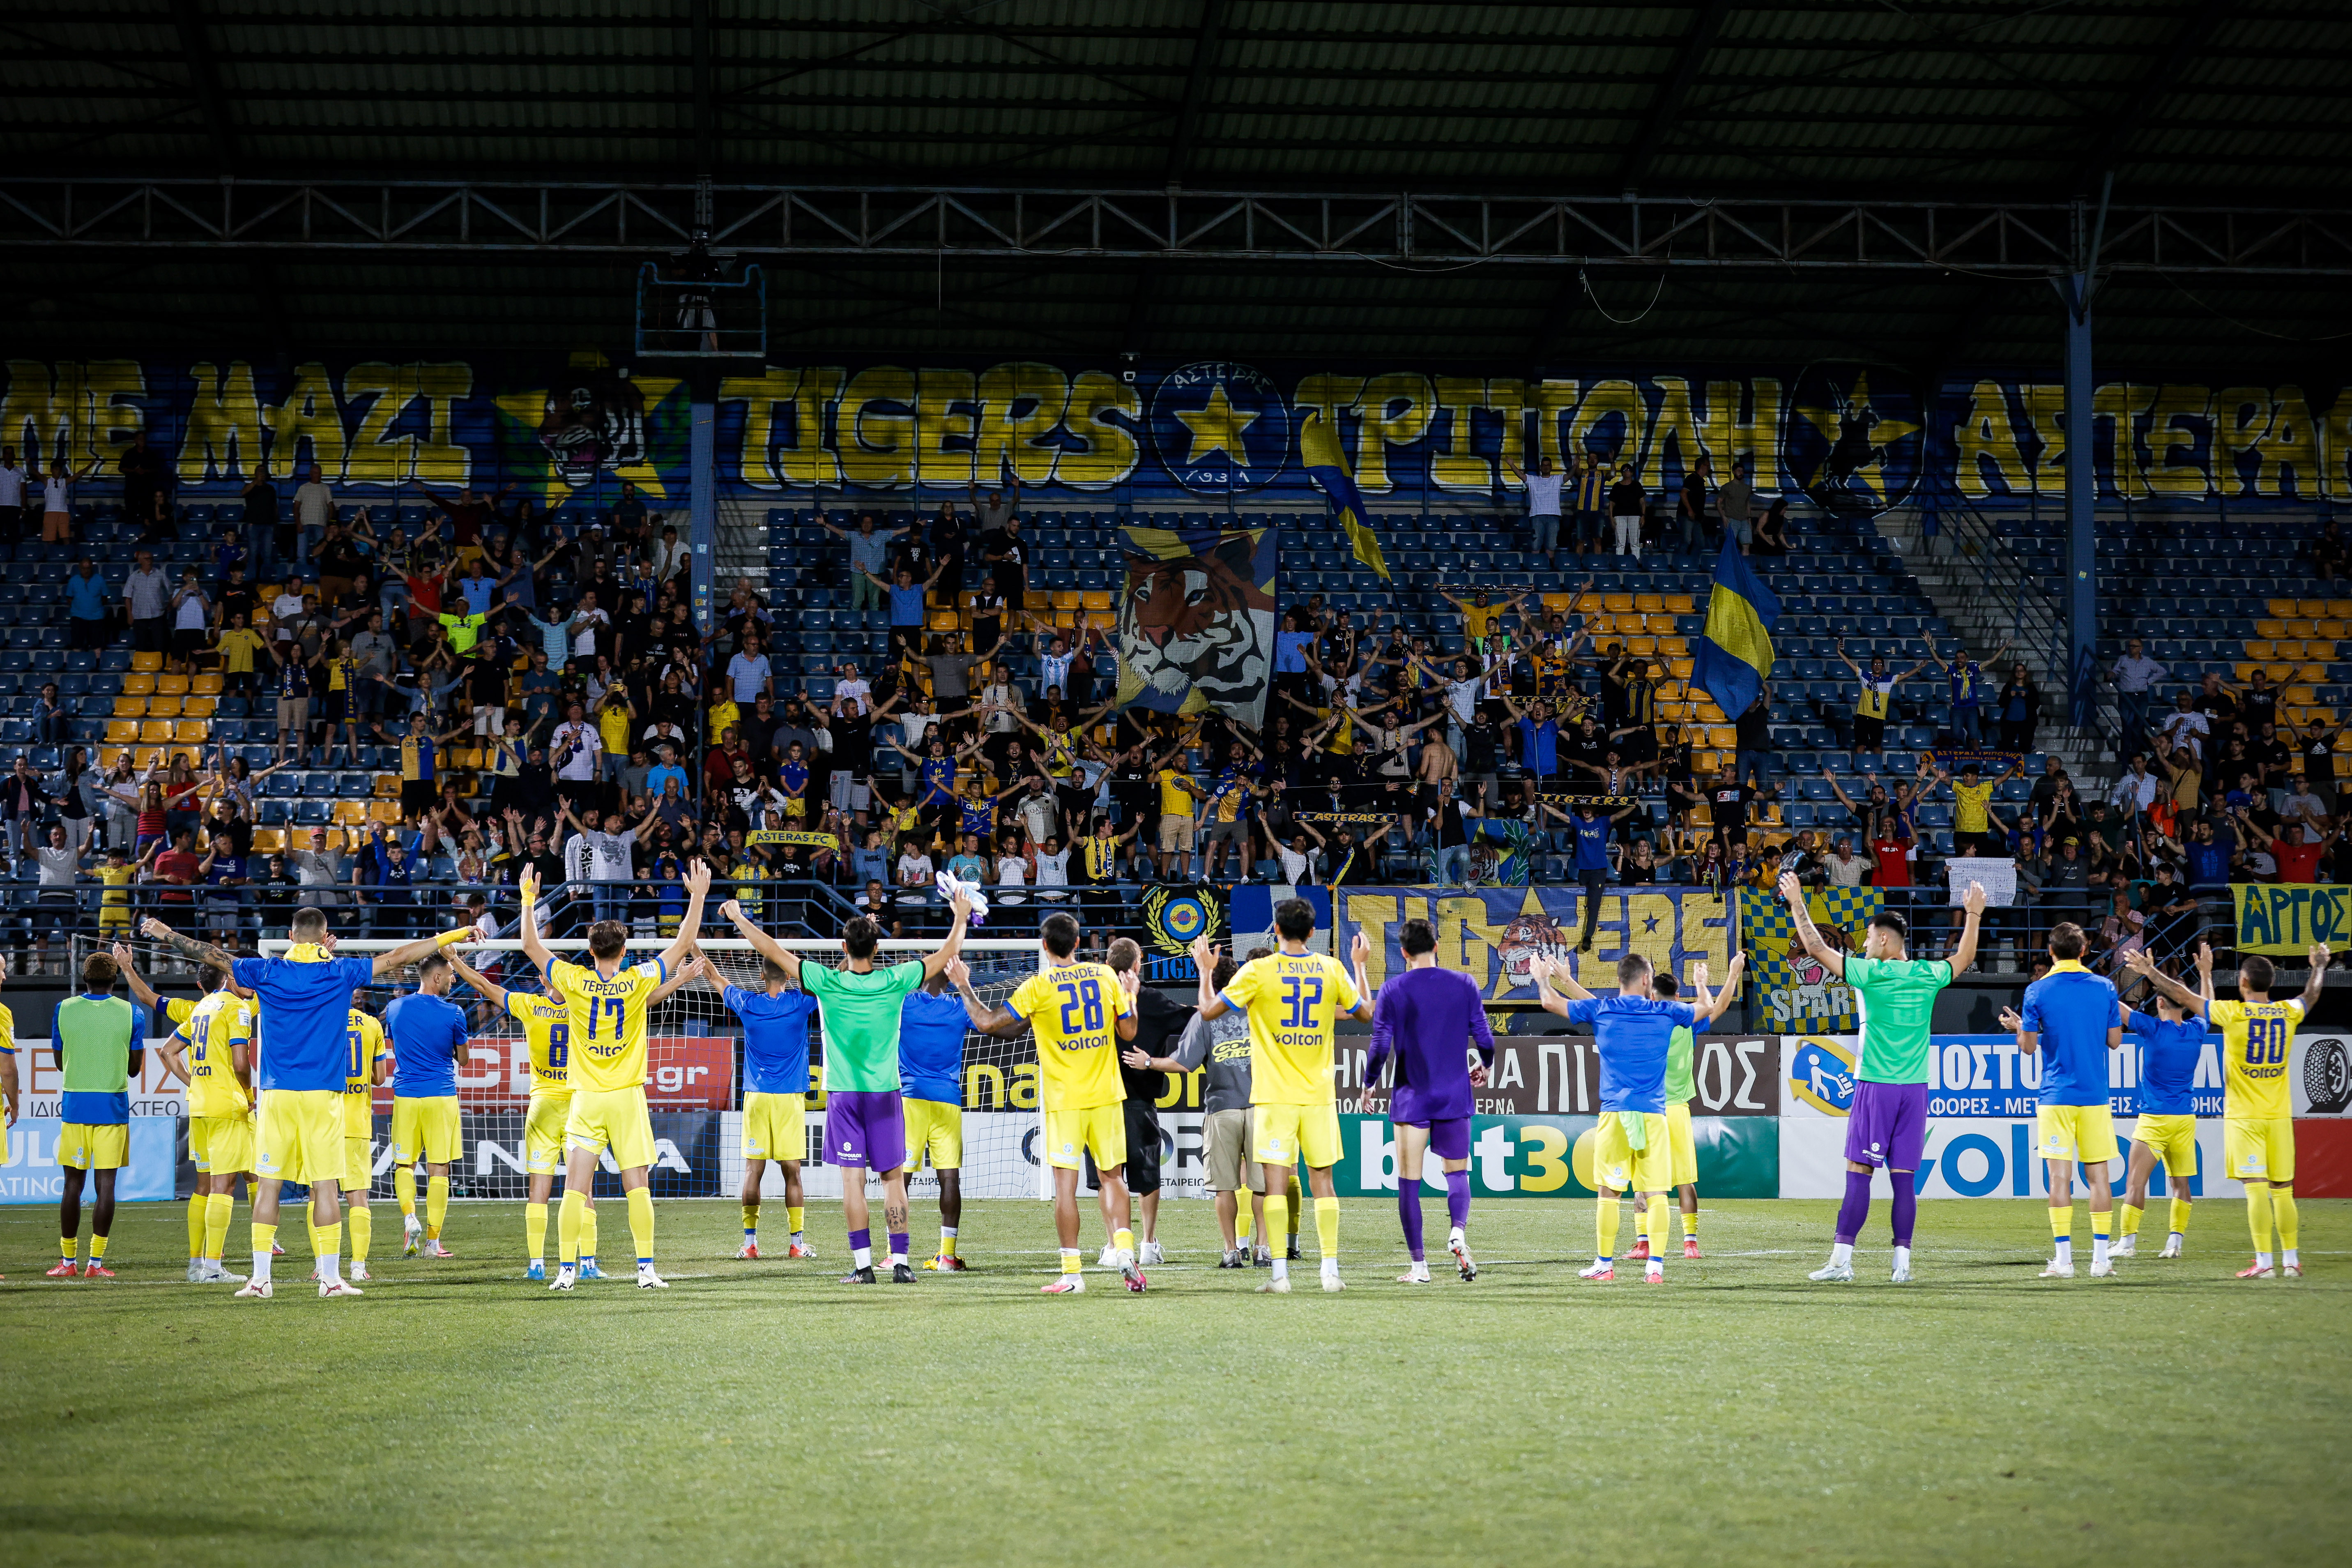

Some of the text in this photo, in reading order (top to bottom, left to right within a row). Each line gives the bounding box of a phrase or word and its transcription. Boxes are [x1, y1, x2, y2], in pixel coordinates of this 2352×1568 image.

[1174, 364, 1270, 394] ΑΣΤΕΡΑΣ
[718, 361, 1142, 490] TIGERS
[1186, 470, 1250, 486] 1931
[1542, 793, 1629, 806] TIGERS
[1314, 813, 1376, 822] ASTERAS
[756, 833, 829, 844] ASTERAS FC
[2242, 886, 2351, 945] ΑΡΓΟΣ
[1347, 893, 1728, 990] TIGERS
[1049, 966, 1103, 985] MENDEZ
[1148, 953, 1200, 980] TIGE
[1277, 962, 1324, 974] J. SILVA
[582, 979, 634, 996] ΤΕΡΕΖΙΟΥ
[1058, 979, 1105, 1035] 28
[1280, 976, 1322, 1028] 32
[1770, 985, 1859, 1022] SPAR
[348, 1015, 364, 1026] ER
[533, 1005, 569, 1019] ΜΠΟΥΖΟ
[588, 996, 624, 1040] 17
[191, 1015, 210, 1061] 39
[549, 1024, 569, 1067] 8
[1056, 1034, 1109, 1051] volton
[1272, 1032, 1322, 1045] volton
[2247, 1018, 2286, 1064] 80
[192, 1066, 211, 1076] lton
[345, 1082, 368, 1095] lton
[1360, 1120, 1597, 1193] bt3
[1160, 1178, 1205, 1187] ΕΤΑΙΡΕΙΩ
[890, 1207, 898, 1216] 51
